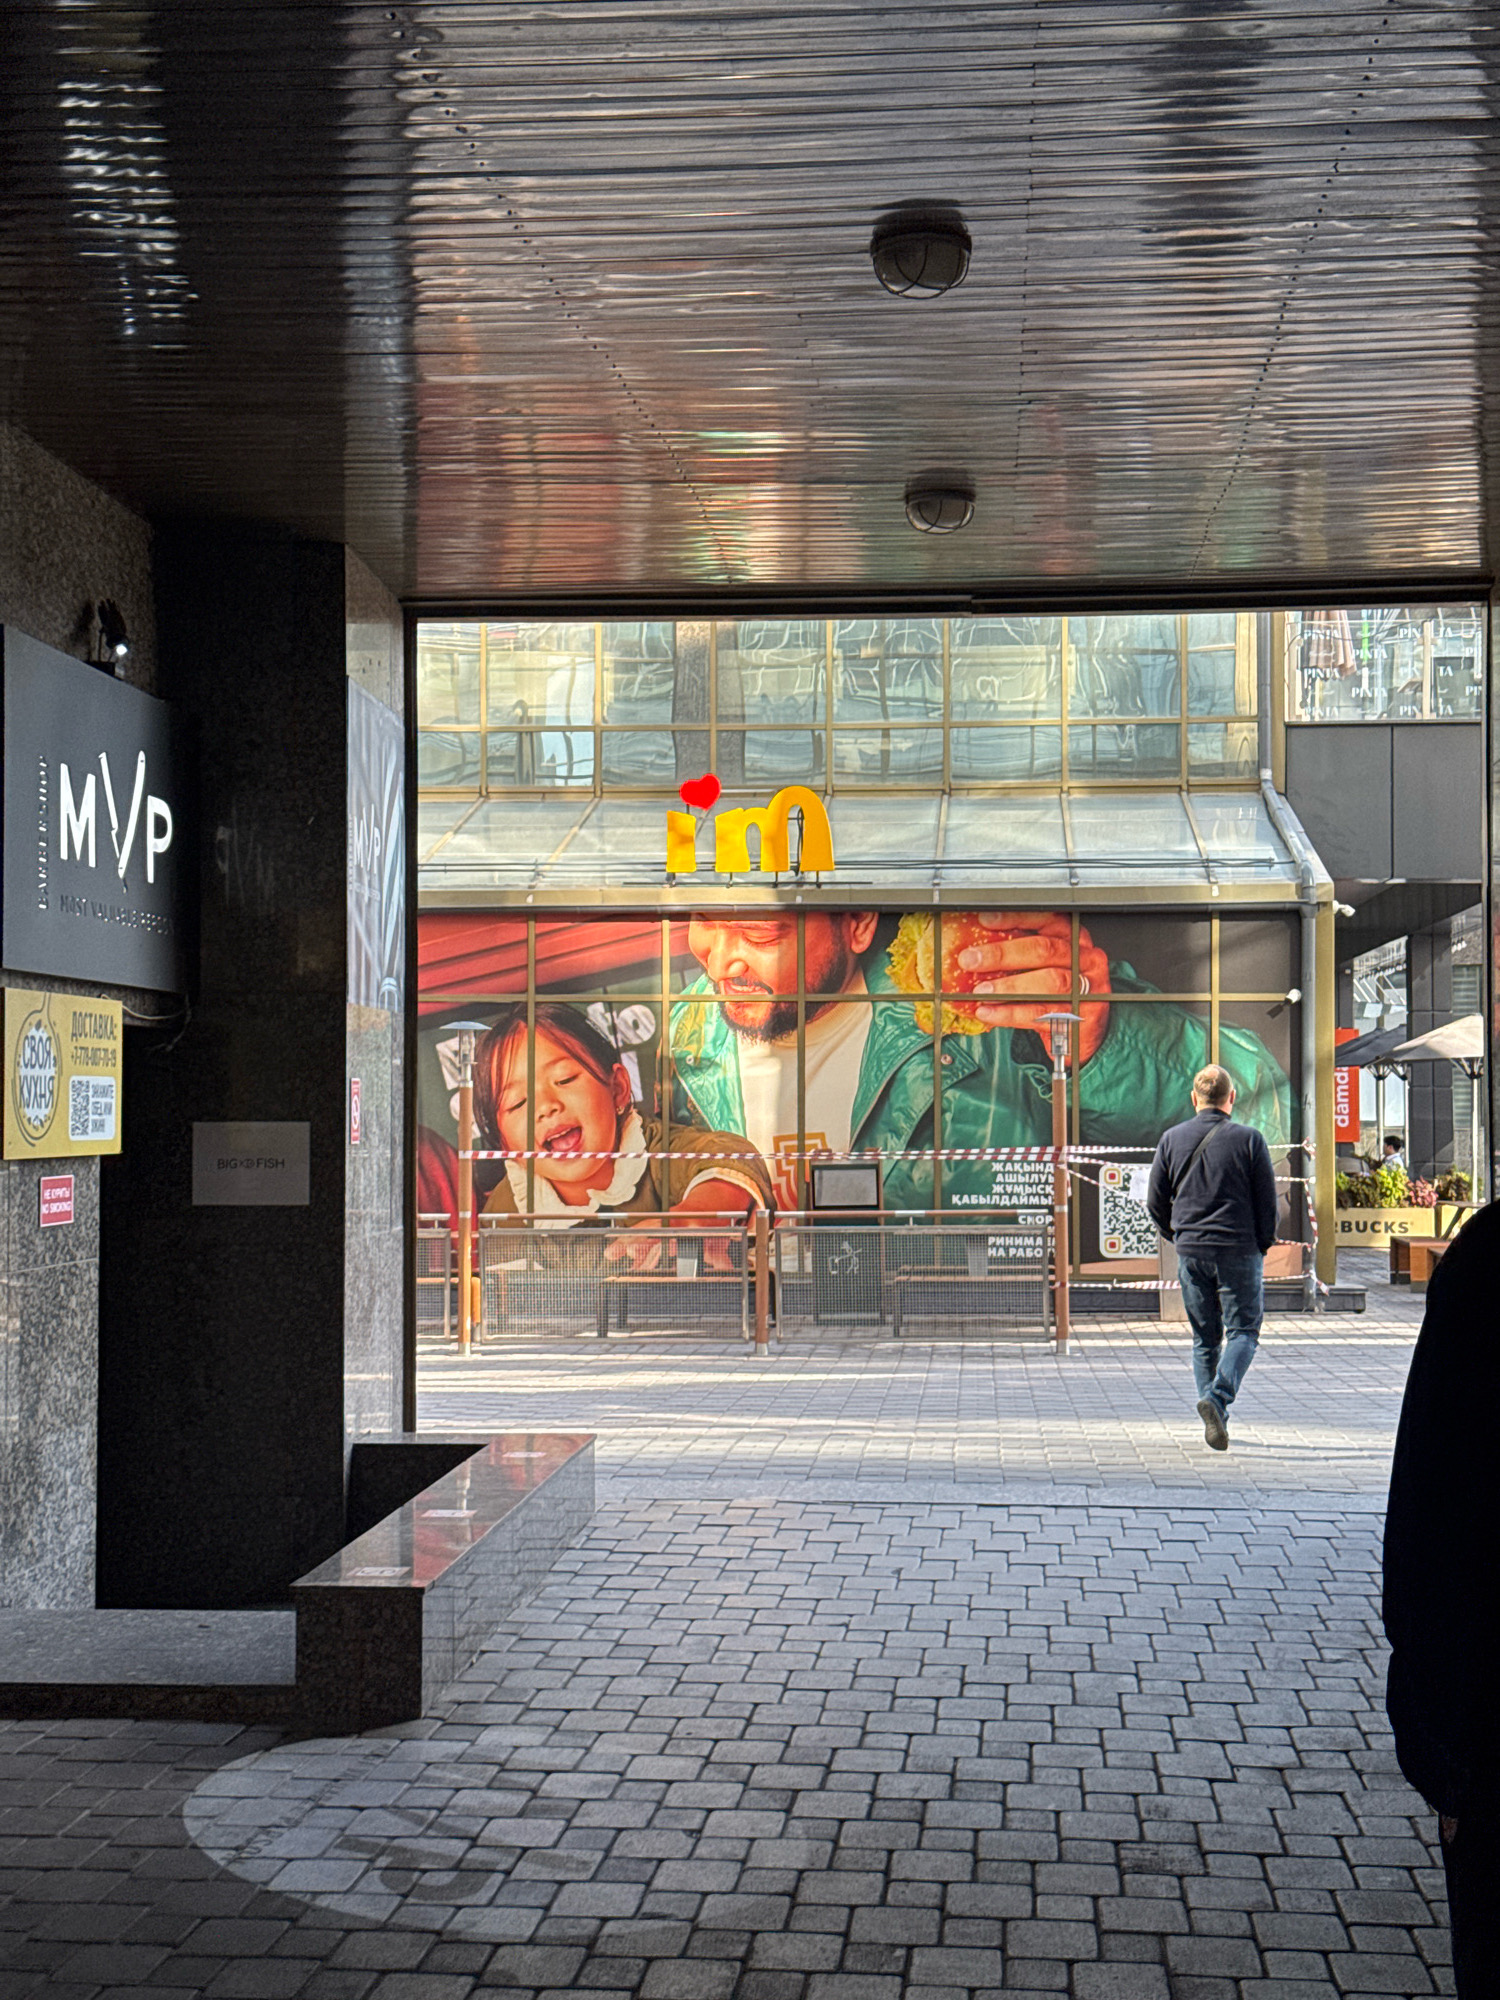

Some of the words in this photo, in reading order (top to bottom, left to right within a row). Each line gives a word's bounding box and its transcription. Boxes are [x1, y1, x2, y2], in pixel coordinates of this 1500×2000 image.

[1304, 667, 1340, 679] PINTA
[1351, 687, 1388, 698] PINTA
[59, 749, 173, 885] MVP
[353, 802, 381, 875] MVP
[70, 1011, 117, 1043] ДОСТАВКА:
[22, 1035, 52, 1070] СВОЯ
[19, 1075, 55, 1110] КУХНЯ
[217, 1158, 238, 1170] BIG
[256, 1157, 285, 1169] FISH
[992, 1161, 1055, 1174] ЖАҚЫНД
[992, 1184, 1055, 1196] ЖҰМЫСҚ
[952, 1195, 1055, 1206] ҚАБЫЛДАЙМЫ
[988, 1247, 1006, 1258] НА
[1009, 1247, 1055, 1258] РАБО
